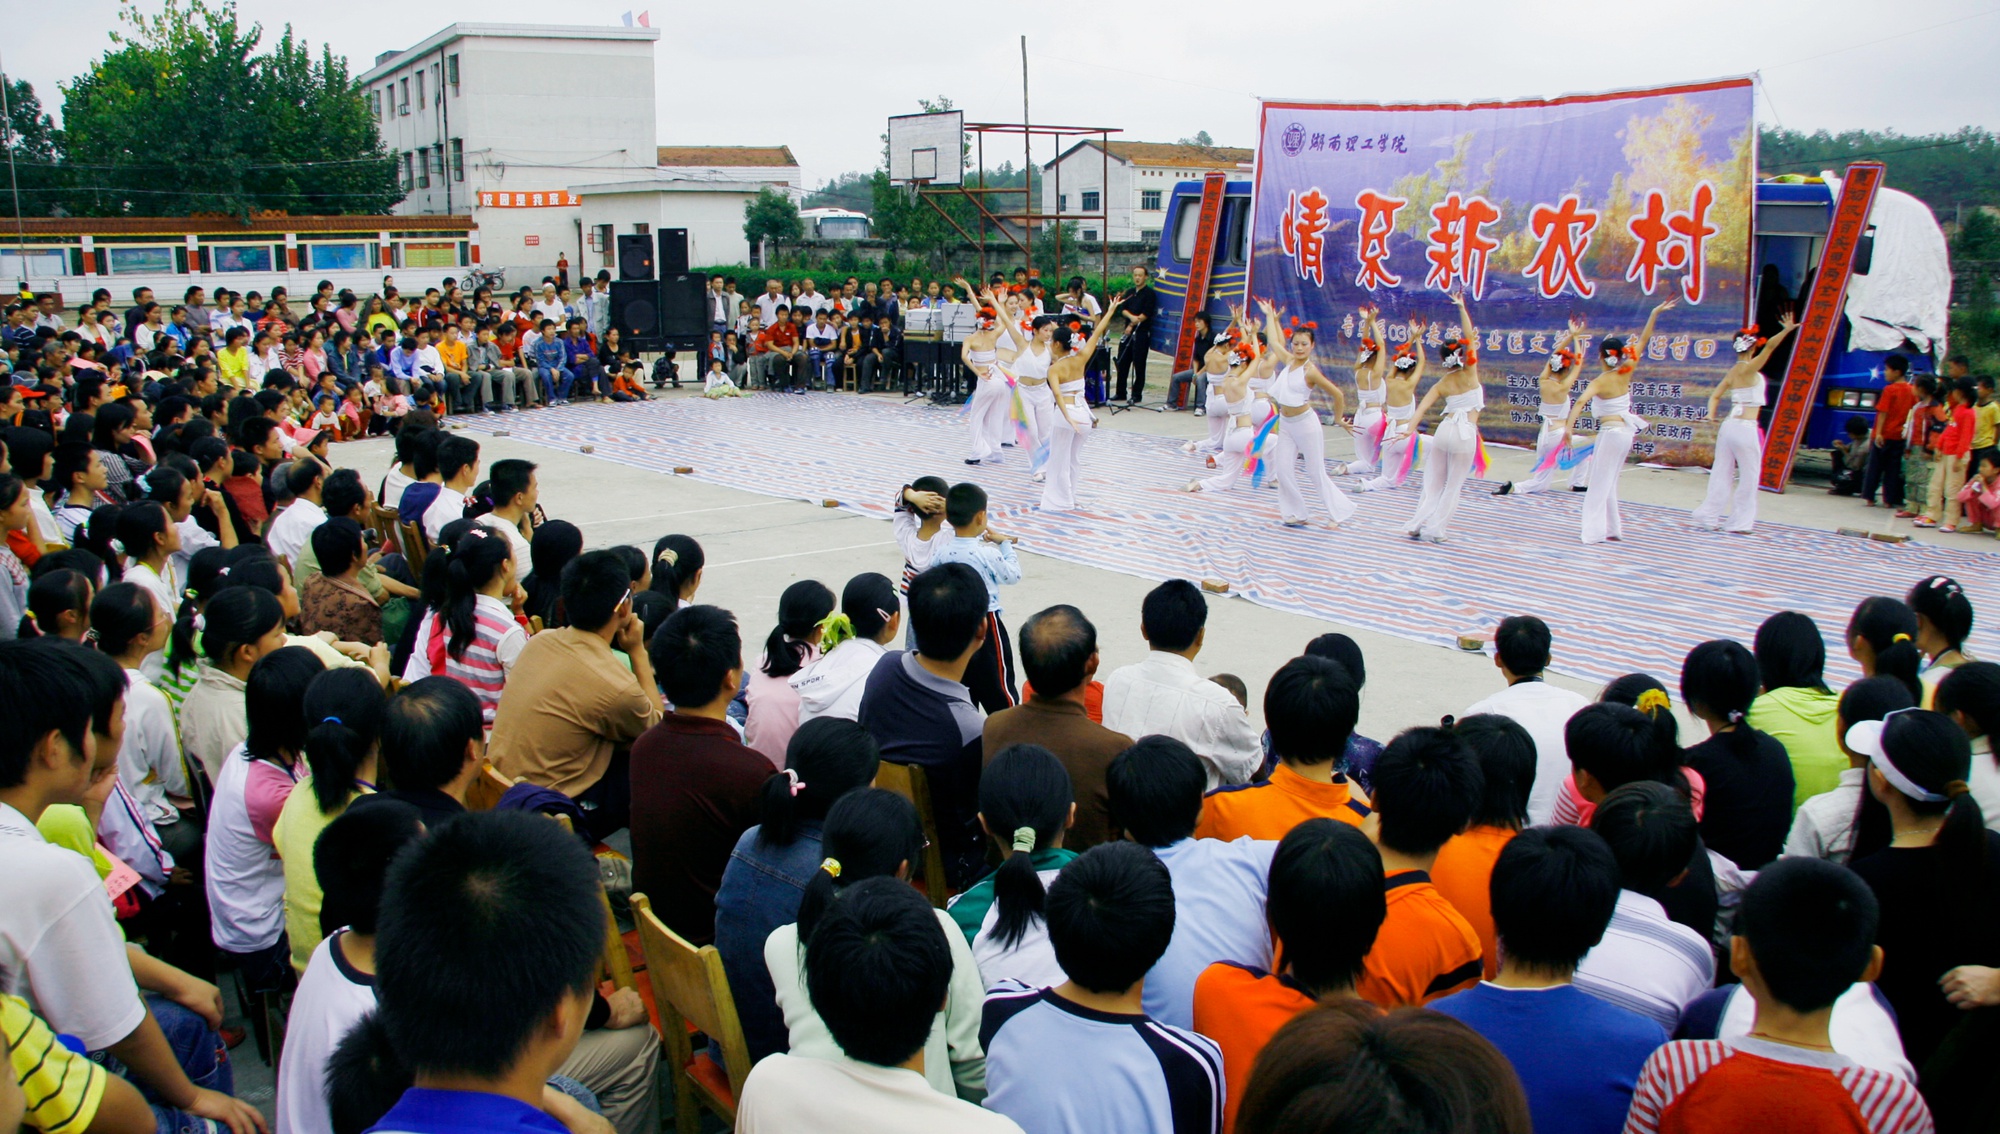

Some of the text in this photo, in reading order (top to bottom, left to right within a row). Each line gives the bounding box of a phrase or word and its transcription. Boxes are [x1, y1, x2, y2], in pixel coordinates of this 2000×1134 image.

[1309, 133, 1407, 153] 湖南理工学院
[801, 675, 825, 686] SPORT
